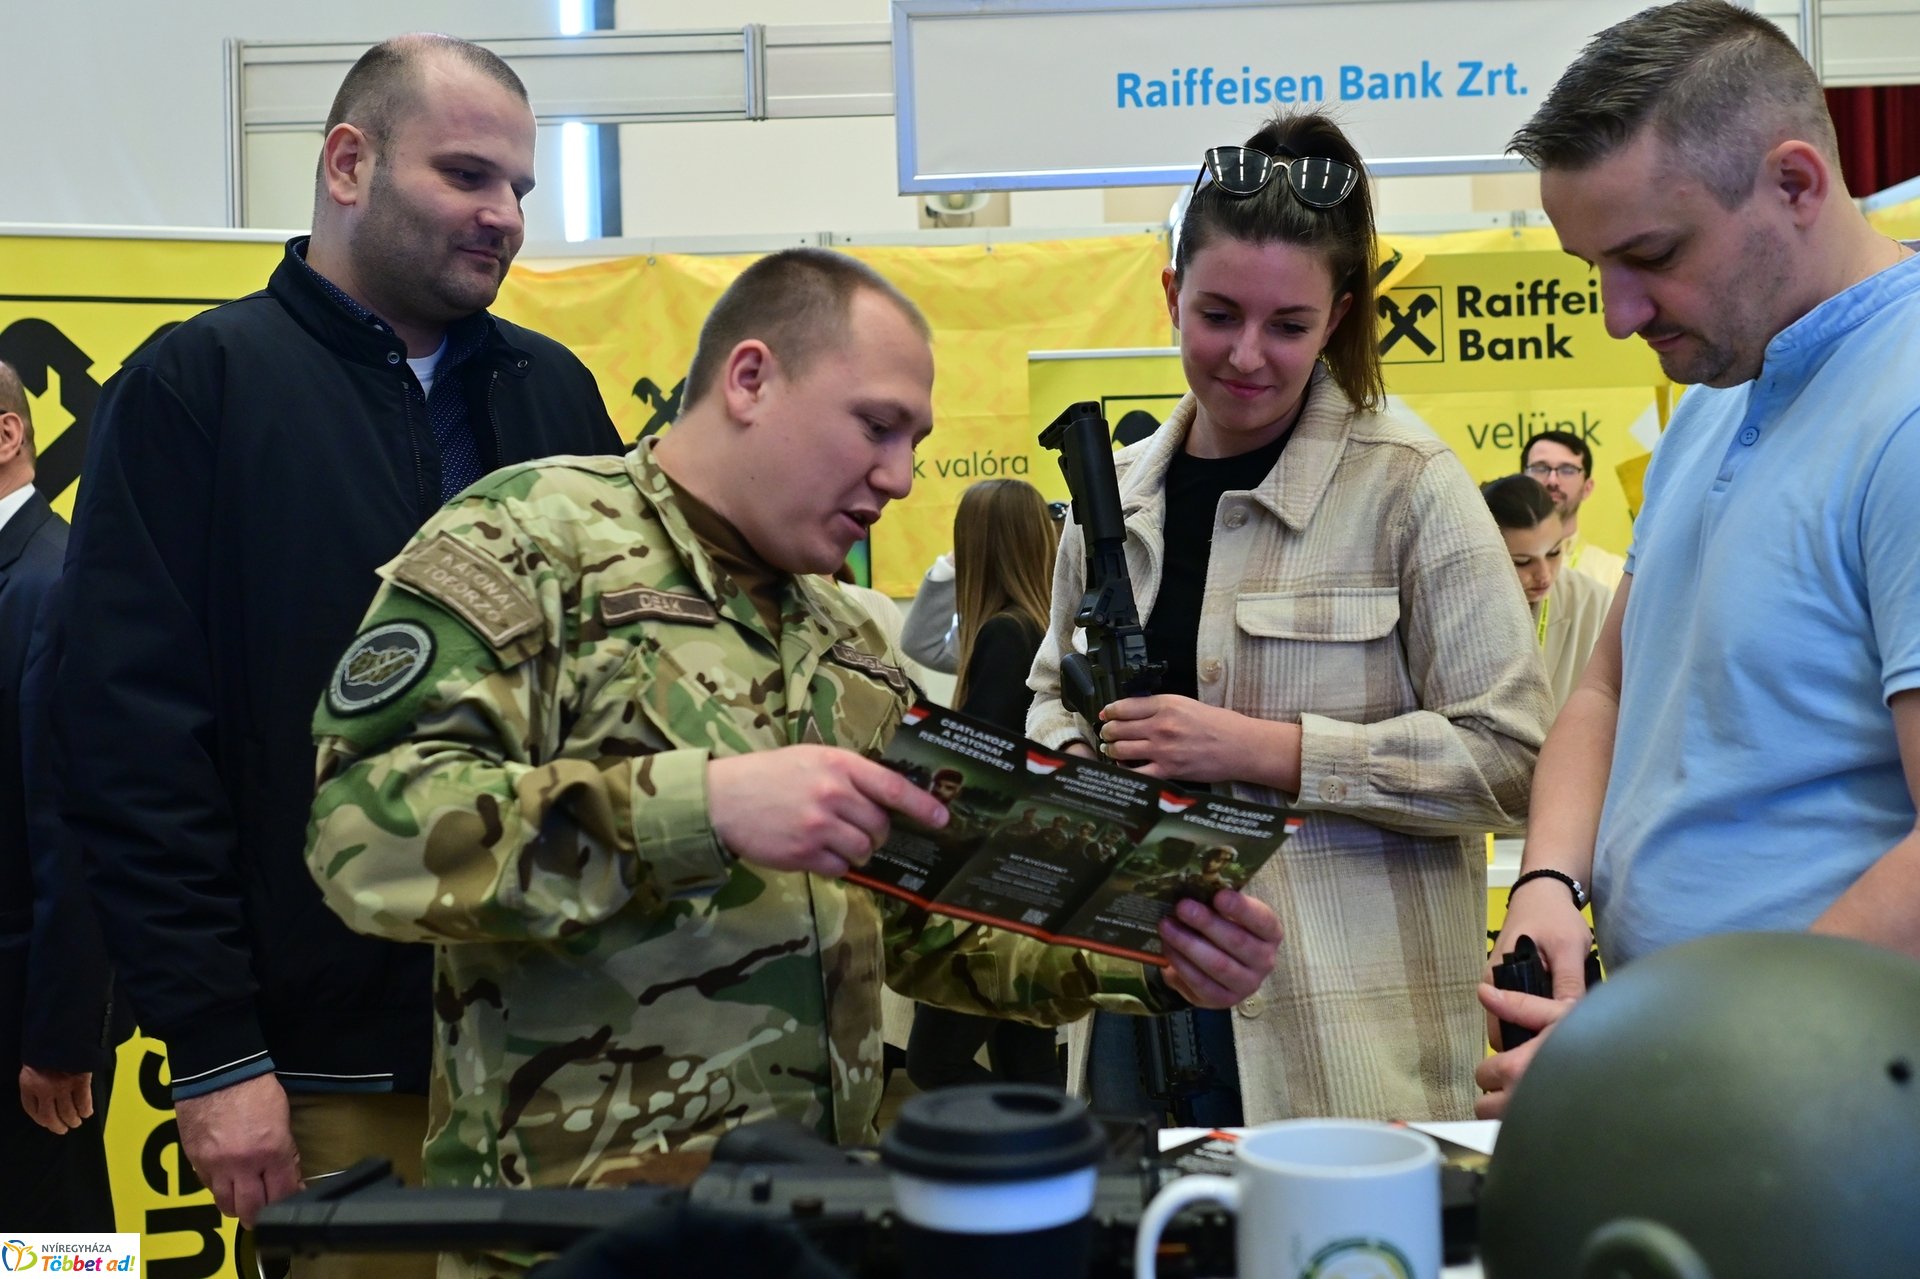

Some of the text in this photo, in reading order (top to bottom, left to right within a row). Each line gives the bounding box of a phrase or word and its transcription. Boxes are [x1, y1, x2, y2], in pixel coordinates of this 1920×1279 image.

[1116, 60, 1528, 108] Raiffeisen Bank Zrt.
[1457, 279, 1604, 318] Raiffei
[1459, 323, 1574, 362] Bank
[1467, 411, 1602, 449] velünk
[935, 450, 1029, 478] valóra
[940, 718, 1015, 751] CSATLAKOZZ
